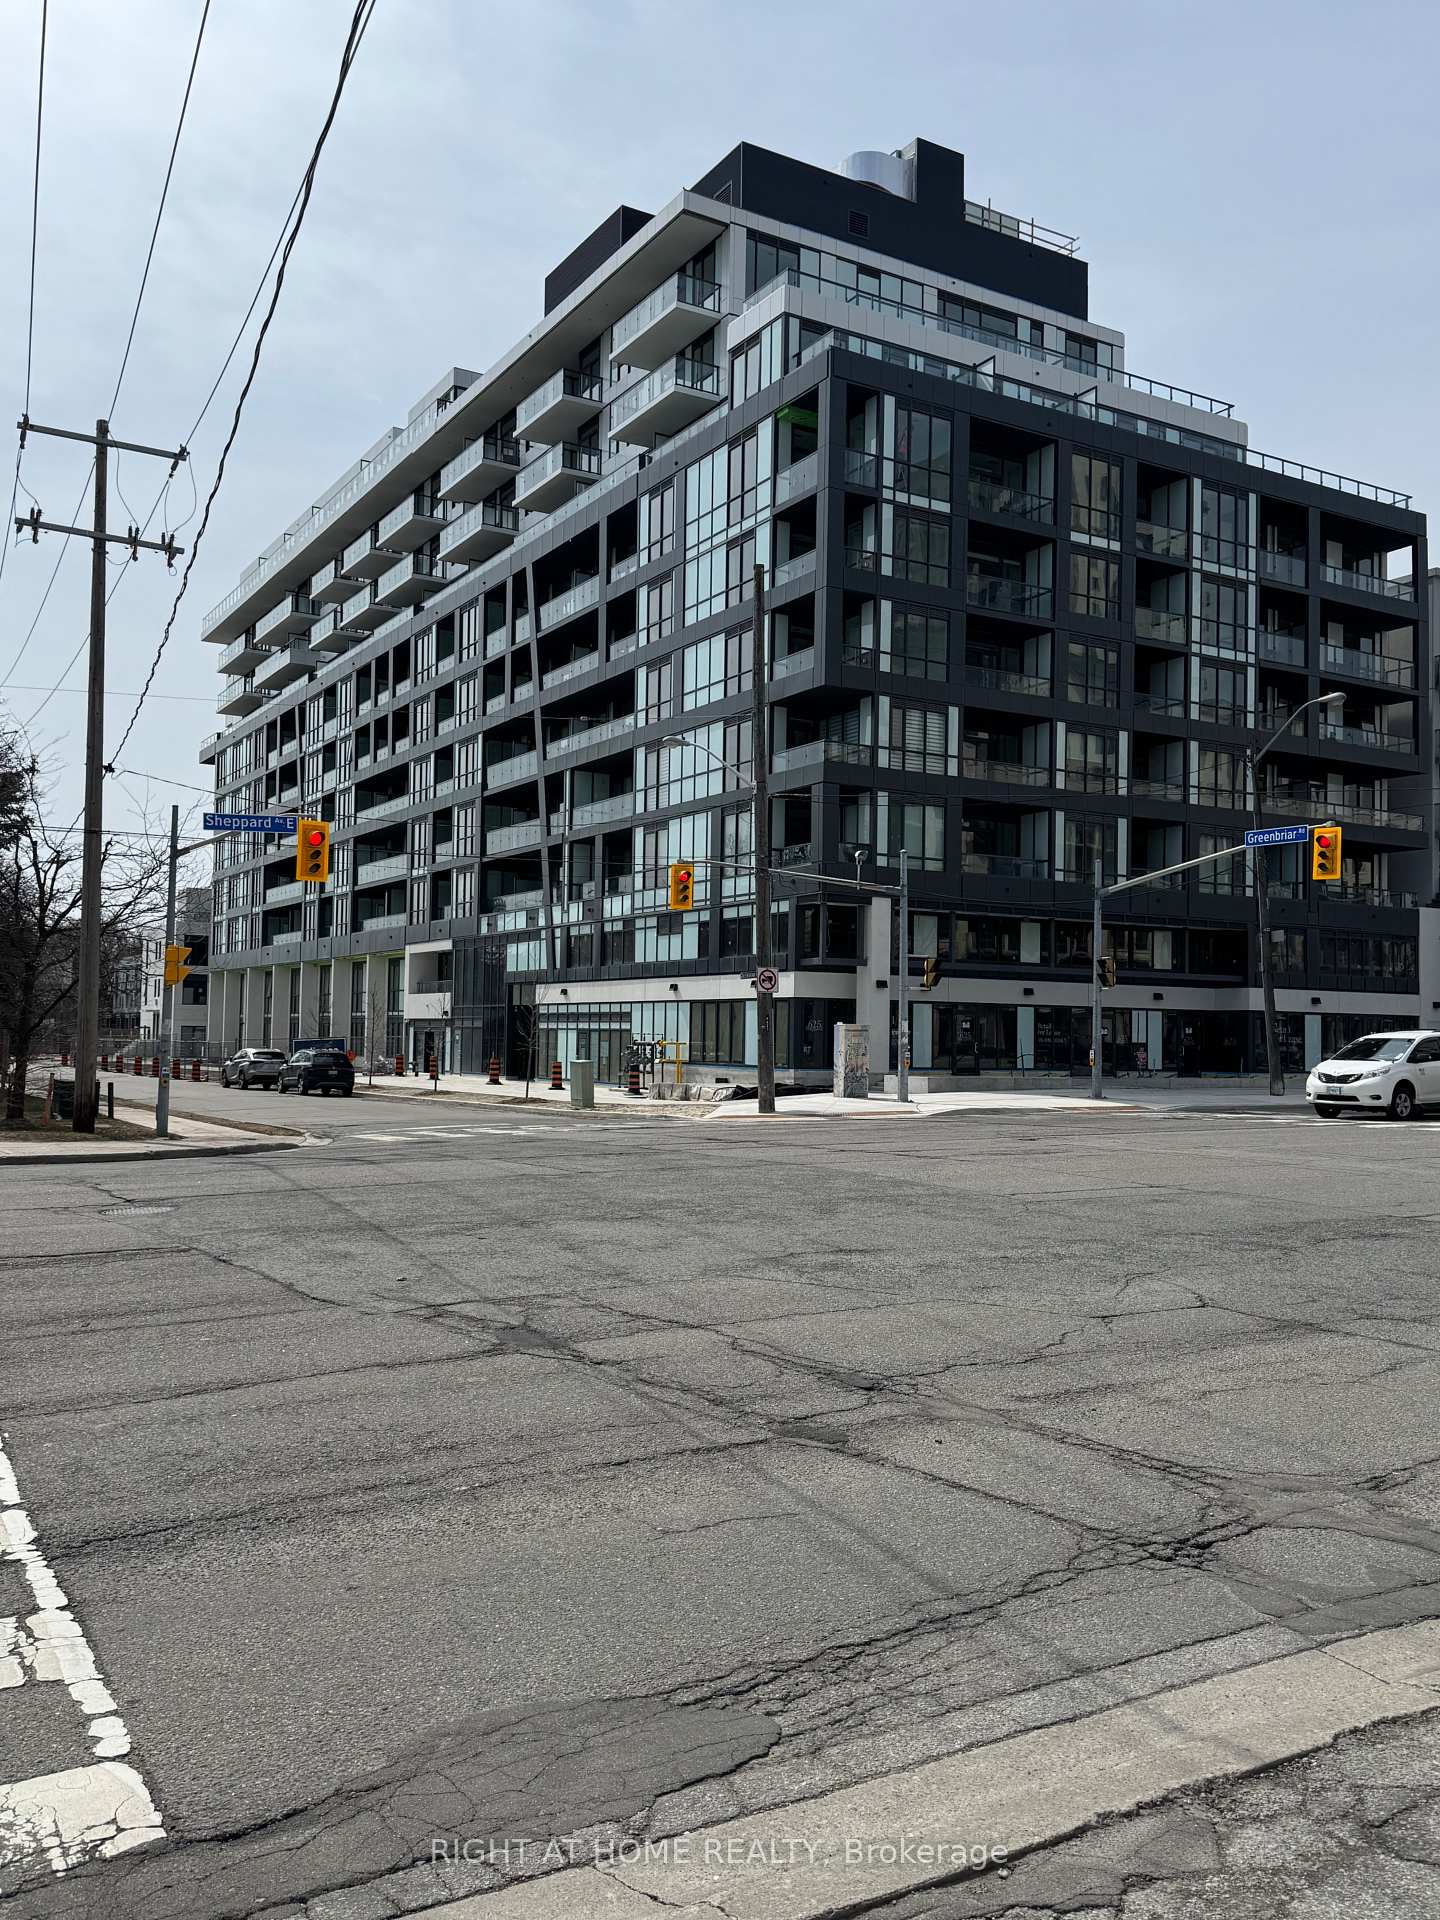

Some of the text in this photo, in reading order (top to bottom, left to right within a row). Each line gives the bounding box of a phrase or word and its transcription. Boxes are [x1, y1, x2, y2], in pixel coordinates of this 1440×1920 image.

[205, 815, 272, 830] Sheppard
[287, 817, 295, 829] E
[1247, 828, 1297, 844] Greenbriar
